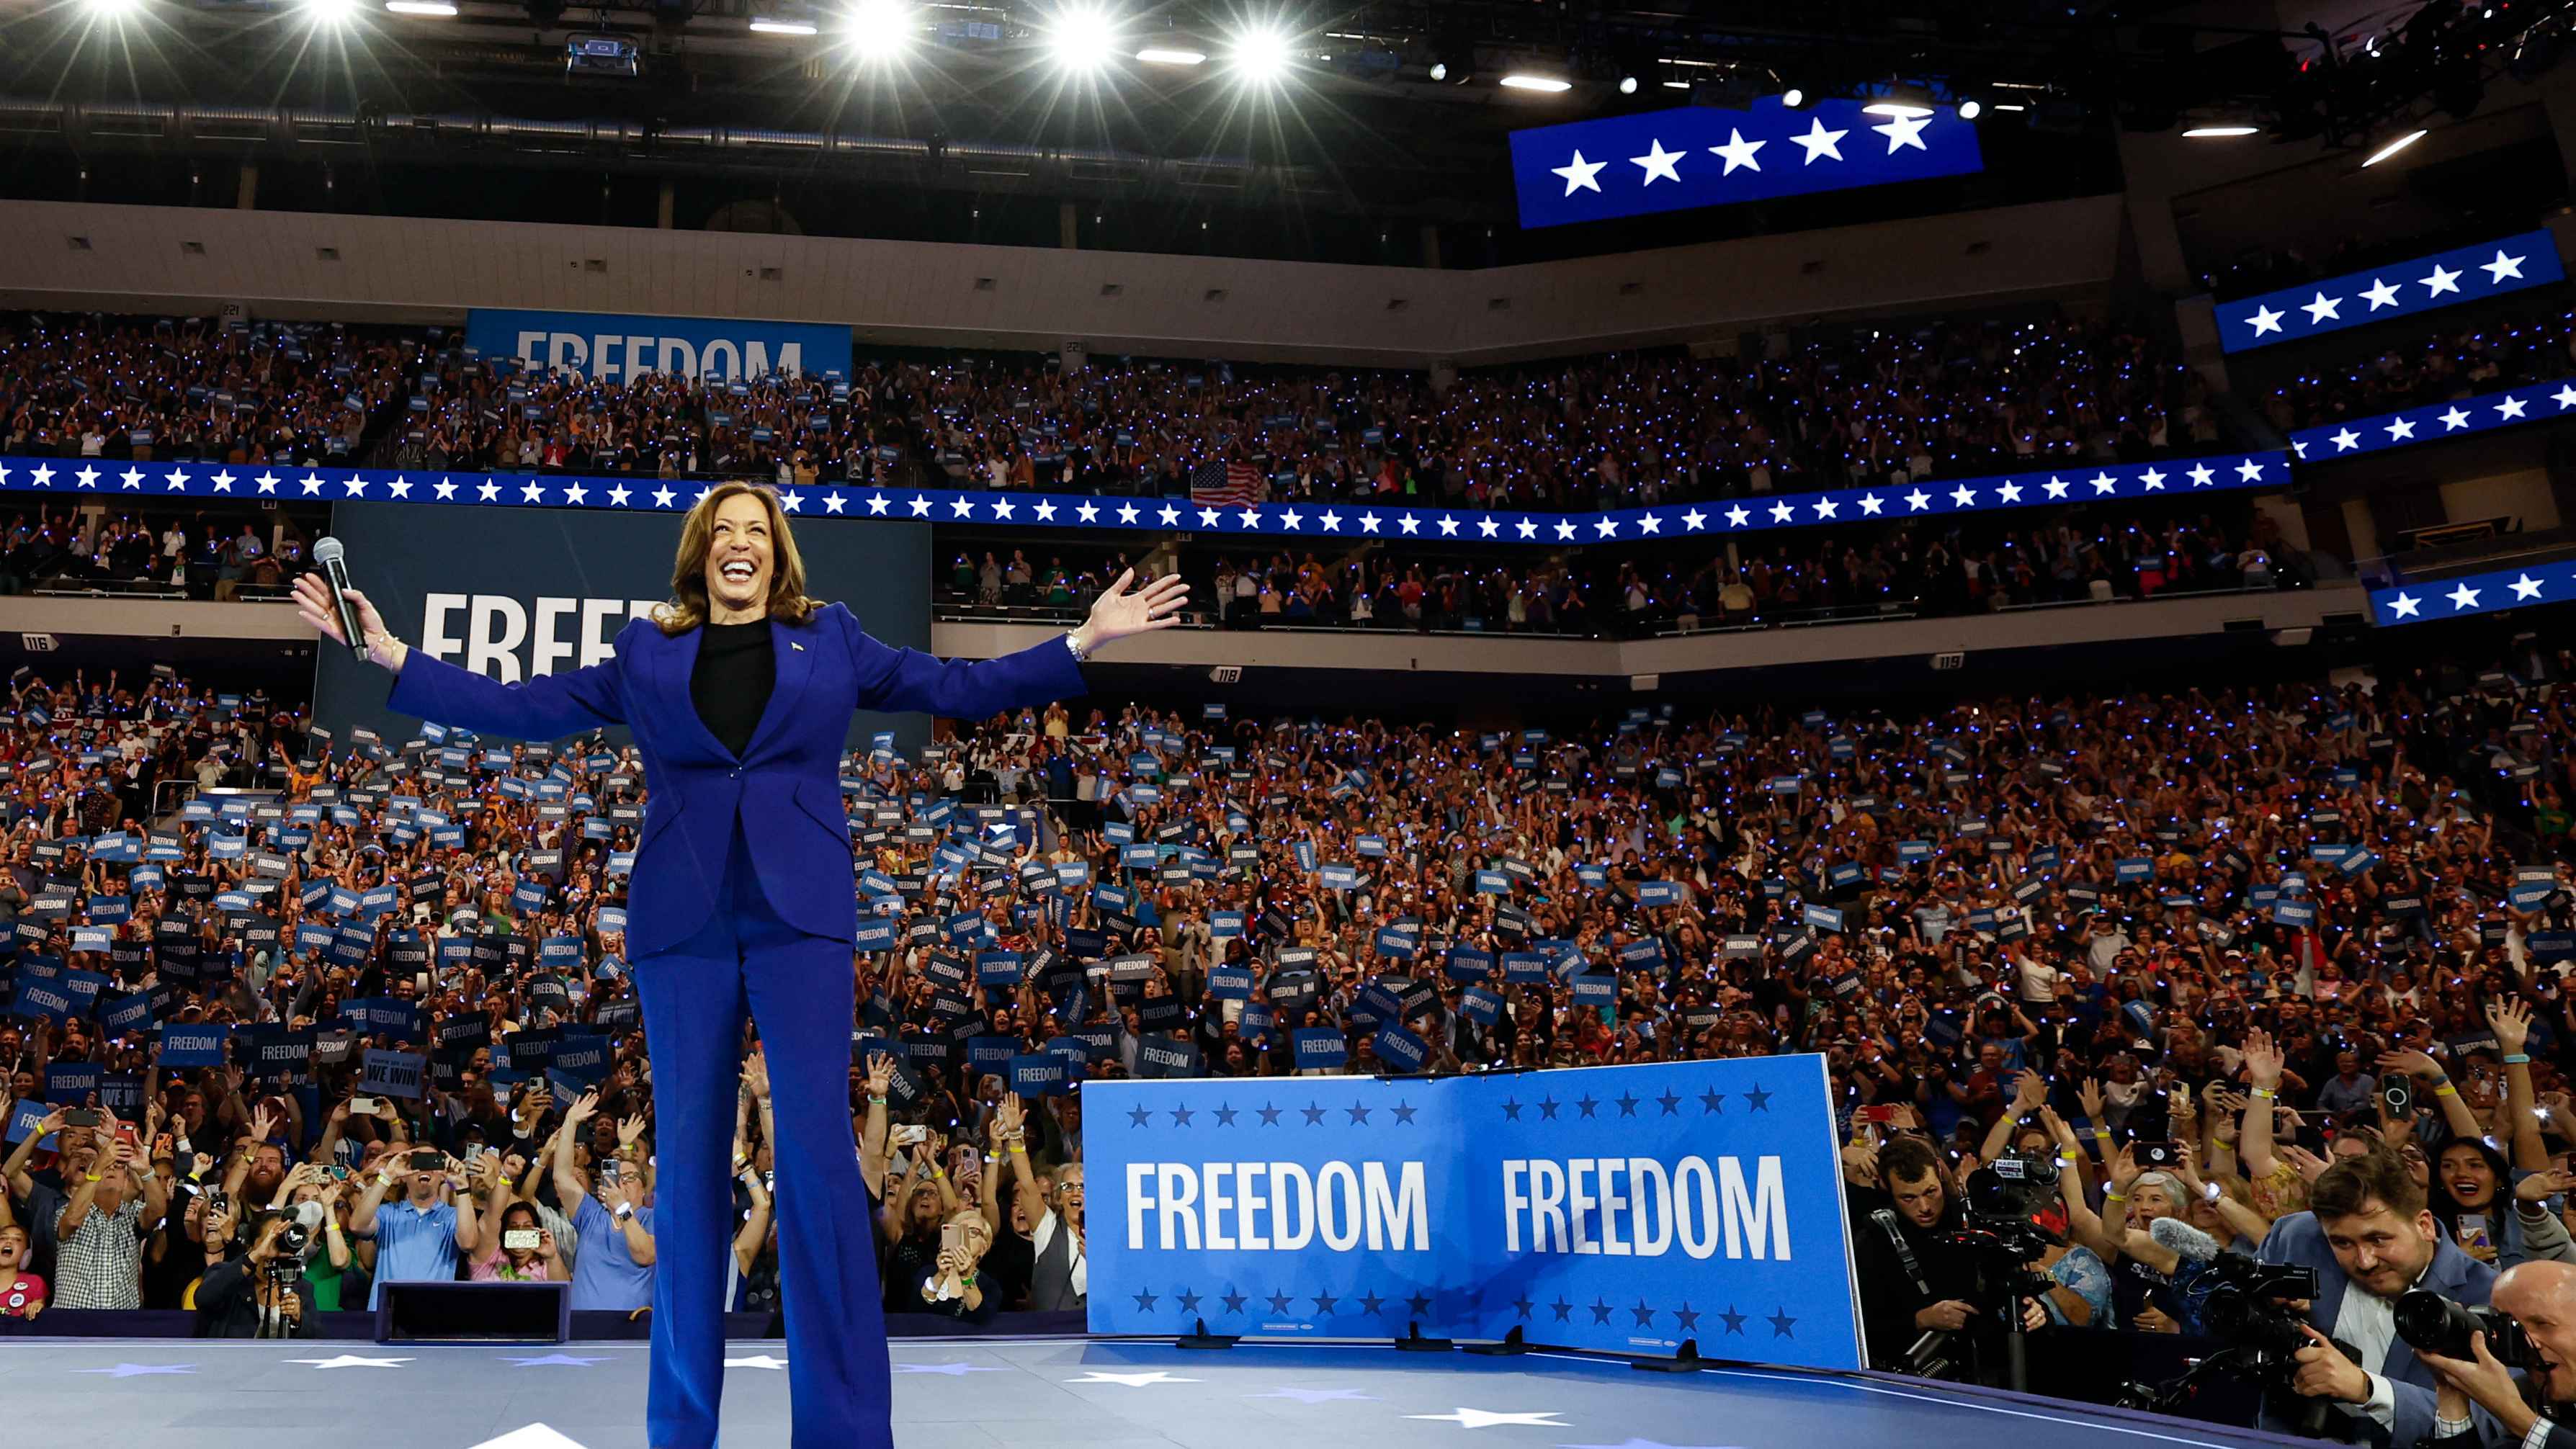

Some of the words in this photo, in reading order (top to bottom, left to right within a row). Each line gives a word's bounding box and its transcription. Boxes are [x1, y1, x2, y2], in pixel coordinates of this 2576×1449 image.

[224, 305, 238, 315] 221
[516, 331, 802, 390] FREEDOM
[27, 637, 47, 650] 116
[421, 593, 670, 686] FREE
[1941, 656, 1960, 668] 119
[1219, 670, 1238, 681] 118
[444, 752, 465, 761] FREEDOM
[421, 771, 443, 779] FREEDOM
[223, 804, 246, 813] FREEDOM
[257, 808, 282, 817] FREEDOM
[335, 810, 357, 820] FREEDOM
[419, 814, 444, 824] FREEDOM
[434, 833, 460, 841] FREEDOM
[864, 833, 885, 843] FREEDOM
[1108, 828, 1131, 837] FREEDOM
[1160, 827, 1183, 838] FREEDOM
[36, 846, 62, 856] FREEDOM
[94, 838, 122, 851] FREEDOM
[214, 841, 241, 851] FREEDOM
[941, 850, 964, 863] FREEDOM
[983, 852, 1007, 864] FREEDOM
[1130, 849, 1155, 858] FREEDOM
[1233, 850, 1256, 858] FREEDOM
[259, 858, 286, 871] FREEDOM
[134, 872, 159, 883] FREEDOM
[1163, 870, 1189, 879] FREEDOM
[1325, 872, 1351, 881] FREEDOM
[413, 881, 439, 894] FREEDOM
[866, 879, 893, 891] FREEDOM
[1029, 878, 1056, 890] FREEDOM
[1481, 876, 1507, 887] FREEDOM
[245, 884, 274, 893] FREEDOM
[303, 886, 327, 902] FREEDOM
[517, 888, 541, 902] FREEDOM
[218, 896, 249, 906] FREEDOM
[334, 895, 357, 908] FREEDOM
[363, 894, 391, 905] FREEDOM
[1099, 892, 1124, 904] FREEDOM
[35, 900, 66, 910] FREEDOM
[93, 903, 124, 915] FREEDOM
[603, 915, 626, 925] FREEDO
[1215, 918, 1241, 928] FREEDOM
[1809, 910, 1836, 923] FREEDOM
[952, 918, 980, 933] FREEDOM
[1106, 916, 1132, 933] FREEDOM
[1498, 918, 1523, 932] FREEDOM
[16, 923, 48, 941] FREEDOM
[302, 932, 332, 945] FREEDOM
[856, 928, 889, 941] FREEDOM
[1382, 935, 1412, 949] FREEDOM
[1727, 941, 1757, 949] FREEDOM
[1783, 938, 1809, 959] FREEDOM
[335, 943, 366, 959] FREEDOM
[392, 950, 425, 961] FREEDOM
[545, 945, 577, 956] FREEDOM
[1624, 946, 1655, 960] FREEDOM
[1282, 952, 1312, 963] FREEDOM
[1454, 958, 1488, 969] FREEDOM
[161, 960, 194, 977] FREEDOM
[931, 962, 964, 980] FREEDOM
[983, 961, 1016, 973] FREEDOM
[1027, 950, 1052, 979] FREEDOM
[1115, 960, 1150, 971] FREEDOM
[1509, 961, 1543, 972] FREEDOM
[1557, 954, 1580, 977] FREEDOM
[68, 979, 99, 993] FREEDO
[533, 982, 565, 995] FREEDOM
[1213, 976, 1248, 988] FREEDOM
[1271, 985, 1297, 998] FREEDOM
[1576, 984, 1611, 995] FREEDOM
[26, 987, 68, 1013] FREEDOM
[1068, 989, 1084, 1022] FREEDOM
[1464, 995, 1495, 1013] FREEDOM
[936, 1000, 969, 1014] FREEDOM
[1142, 1002, 1179, 1020] FREEDOM
[108, 1002, 146, 1026] FREEDOM
[370, 1009, 406, 1025] FREEDOM
[1687, 1015, 1717, 1026] FREEDOM
[442, 1023, 483, 1041] FREEDOM
[954, 1020, 984, 1040] FREEDOM
[169, 1036, 217, 1051] FREEDOM
[1302, 1039, 1344, 1052] FREEDOM
[1384, 1031, 1423, 1062] FREEDOM
[261, 1044, 308, 1060] FREEDOM
[911, 1044, 947, 1057] FREEDOM
[975, 1049, 1014, 1060] FREEDOM
[1144, 1047, 1188, 1067] FREEDOM
[557, 1051, 600, 1068] FREEDOM
[368, 1064, 388, 1082] WE
[390, 1067, 416, 1086] WIN
[1018, 1068, 1062, 1082] FREEDOM
[51, 1075, 94, 1089] FREEDOM
[1126, 1161, 1429, 1251] FREEDOM
[1503, 1154, 1791, 1261] FREEDOM
